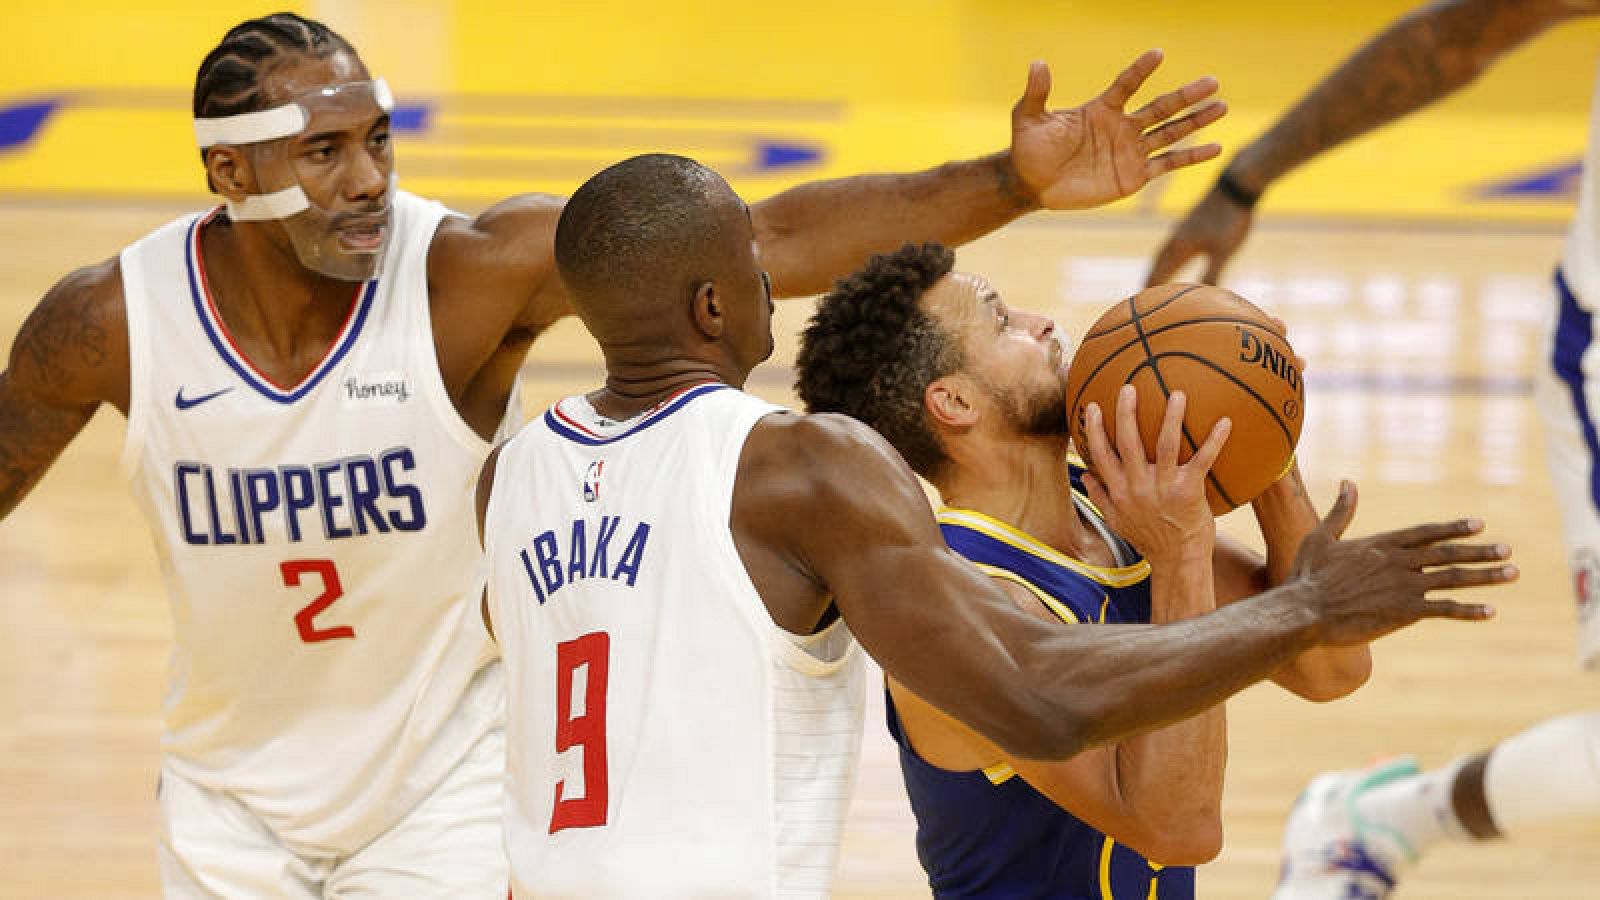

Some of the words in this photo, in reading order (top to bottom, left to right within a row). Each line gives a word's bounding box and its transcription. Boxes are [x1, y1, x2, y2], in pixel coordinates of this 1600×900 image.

[344, 376, 409, 403] honey
[174, 446, 427, 545] CLIPPERS
[279, 559, 356, 643] 2
[520, 515, 651, 605] IBAKA
[548, 632, 609, 834] 9
